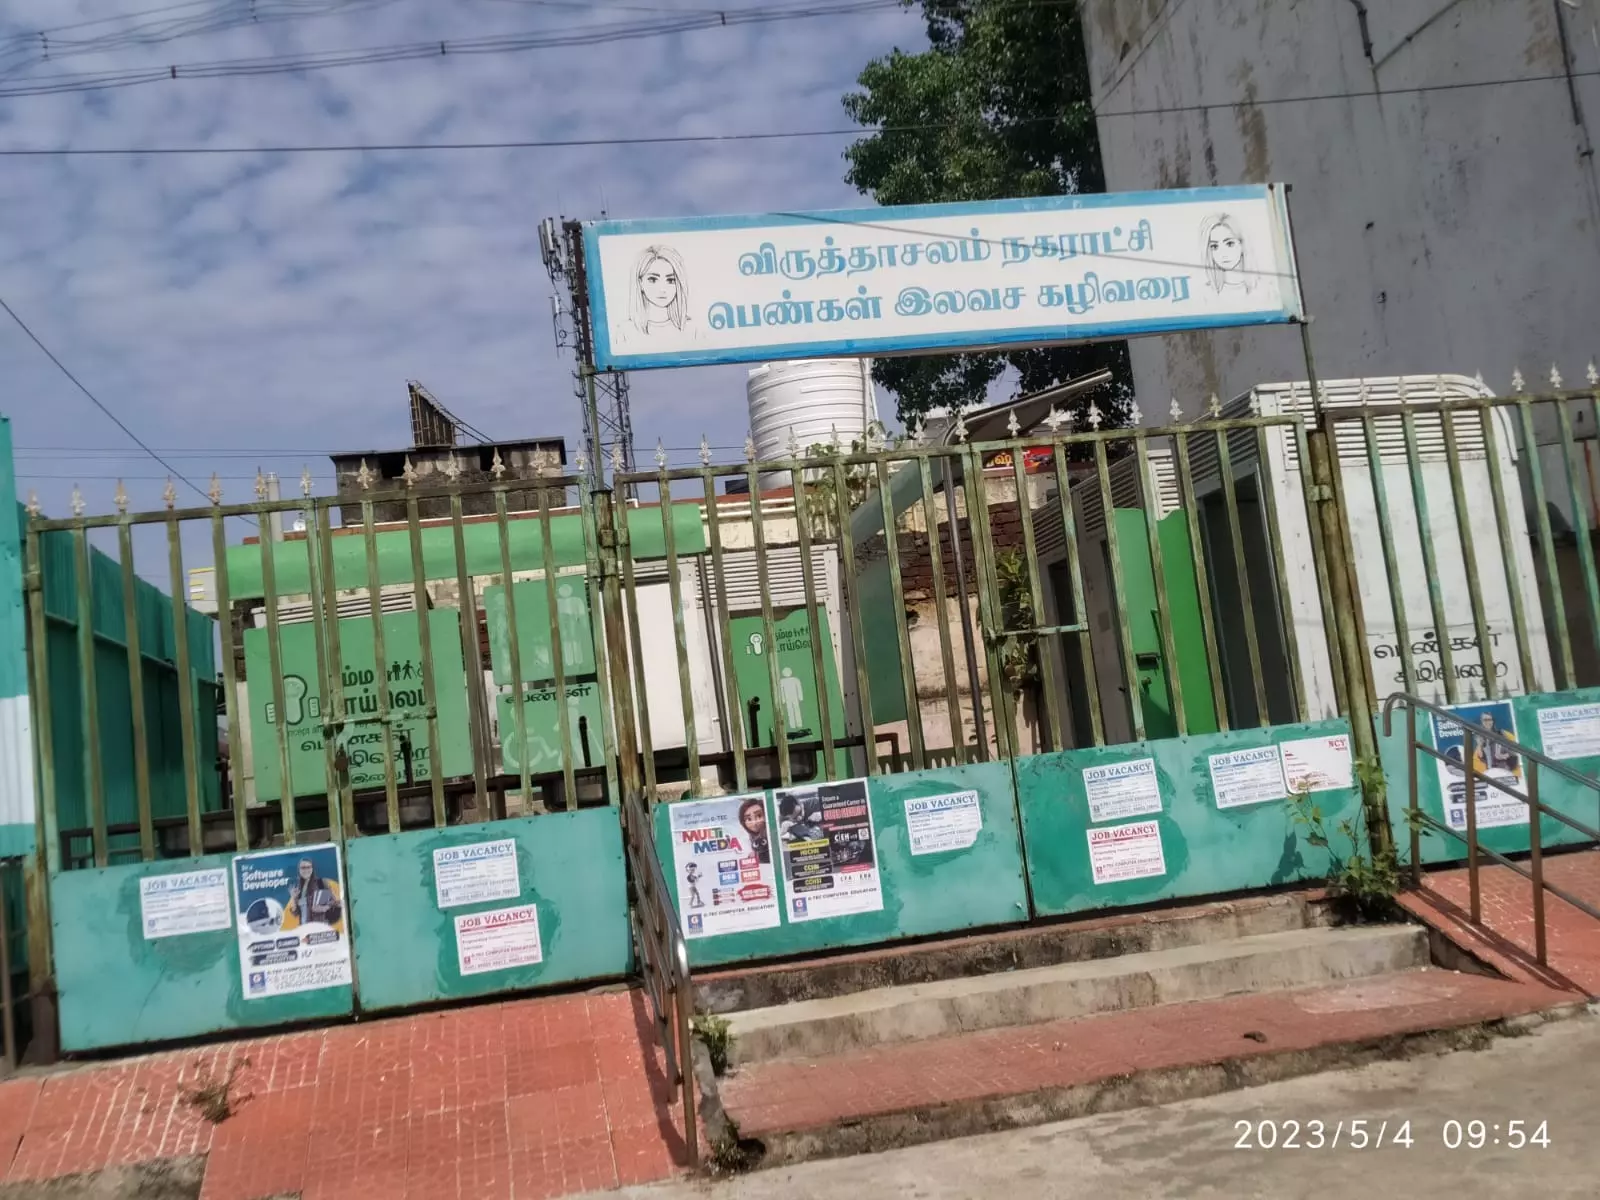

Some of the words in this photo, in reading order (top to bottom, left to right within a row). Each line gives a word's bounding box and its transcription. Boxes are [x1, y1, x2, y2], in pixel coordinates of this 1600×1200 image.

[738, 227, 991, 280] விருத்தாசலம்
[1002, 218, 1154, 268] நகராட்சி
[707, 285, 882, 330] பெண்கள்
[894, 285, 1027, 316] இலவச
[1213, 756, 1231, 766] JOB
[1233, 749, 1276, 762] VACANCY
[1087, 770, 1106, 780] JOB
[1108, 762, 1152, 777] VACANCY
[909, 802, 928, 811] JOB
[930, 794, 976, 809] VACANCY
[1092, 831, 1111, 841] JOB
[1113, 824, 1156, 839] VACANCY
[438, 851, 460, 861] JOB
[462, 843, 513, 858] VACANCY
[145, 879, 168, 892] JOB
[170, 872, 225, 887] VACANCY
[241, 868, 284, 881] Software
[242, 877, 289, 892] Developer
[460, 918, 482, 928] JOB
[484, 909, 534, 925] VACANCY
